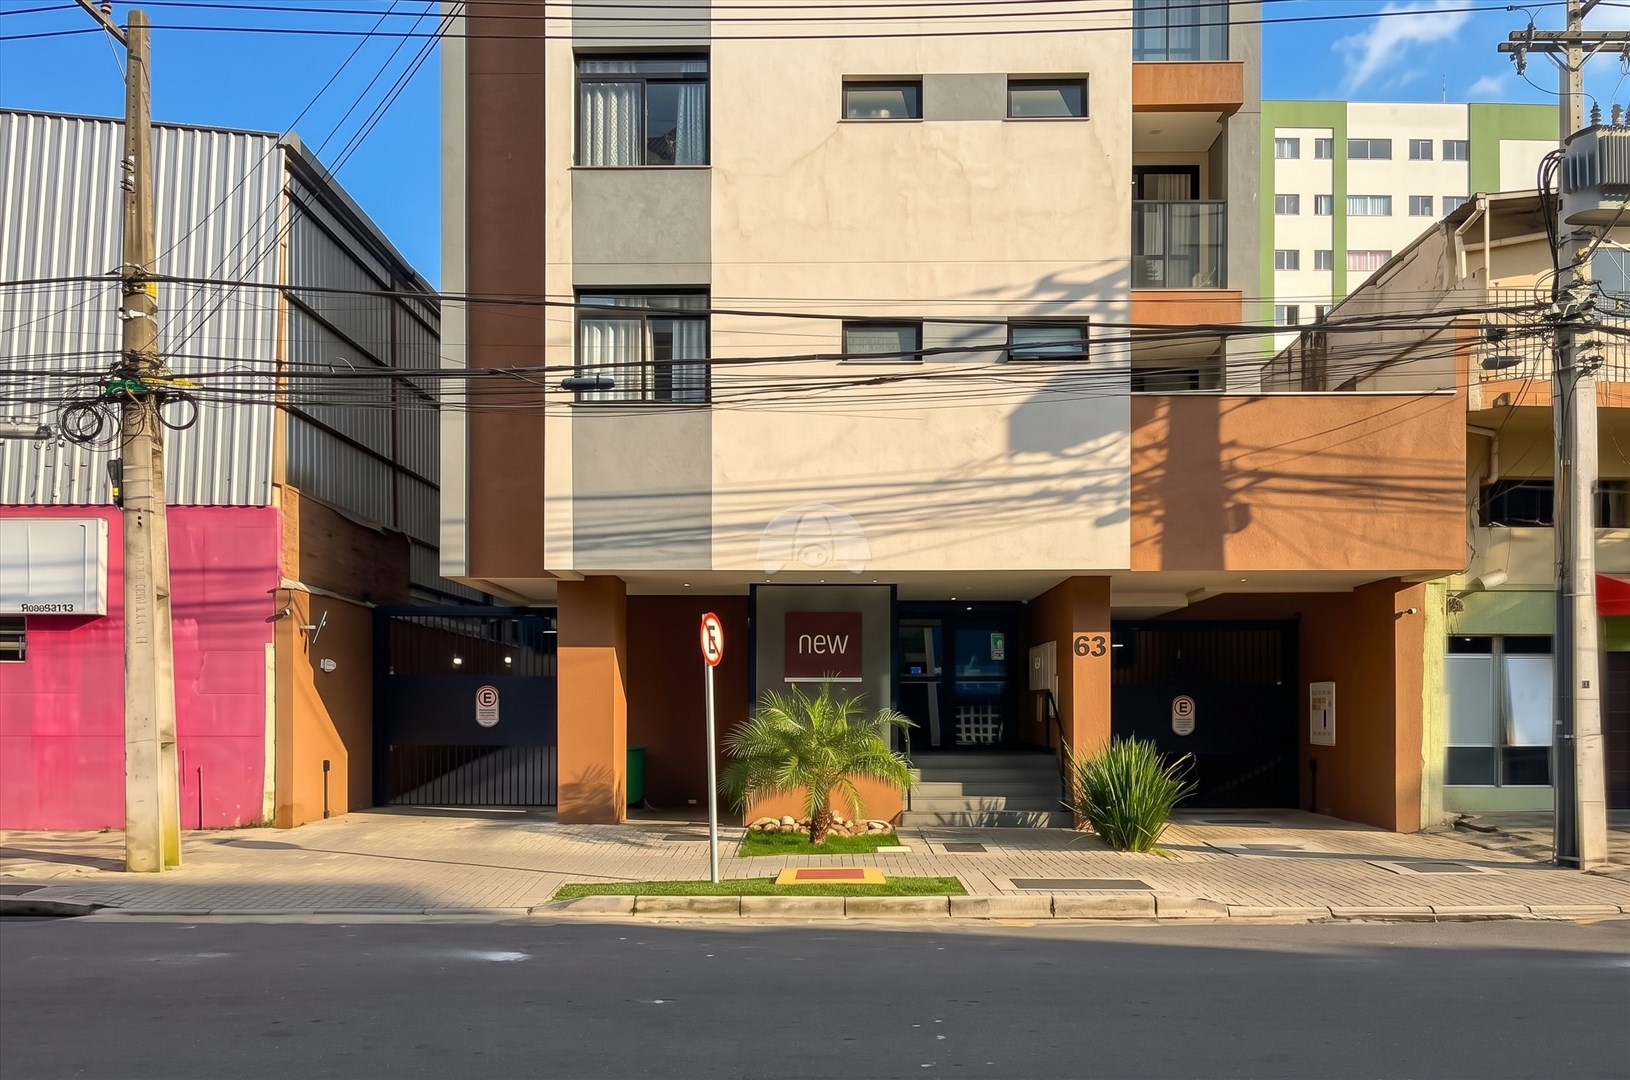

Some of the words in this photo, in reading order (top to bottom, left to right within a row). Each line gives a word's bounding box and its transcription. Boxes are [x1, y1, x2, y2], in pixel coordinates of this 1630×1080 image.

[799, 634, 849, 654] new
[1074, 636, 1107, 657] 63
[483, 692, 492, 703] E
[1179, 702, 1188, 713] E
